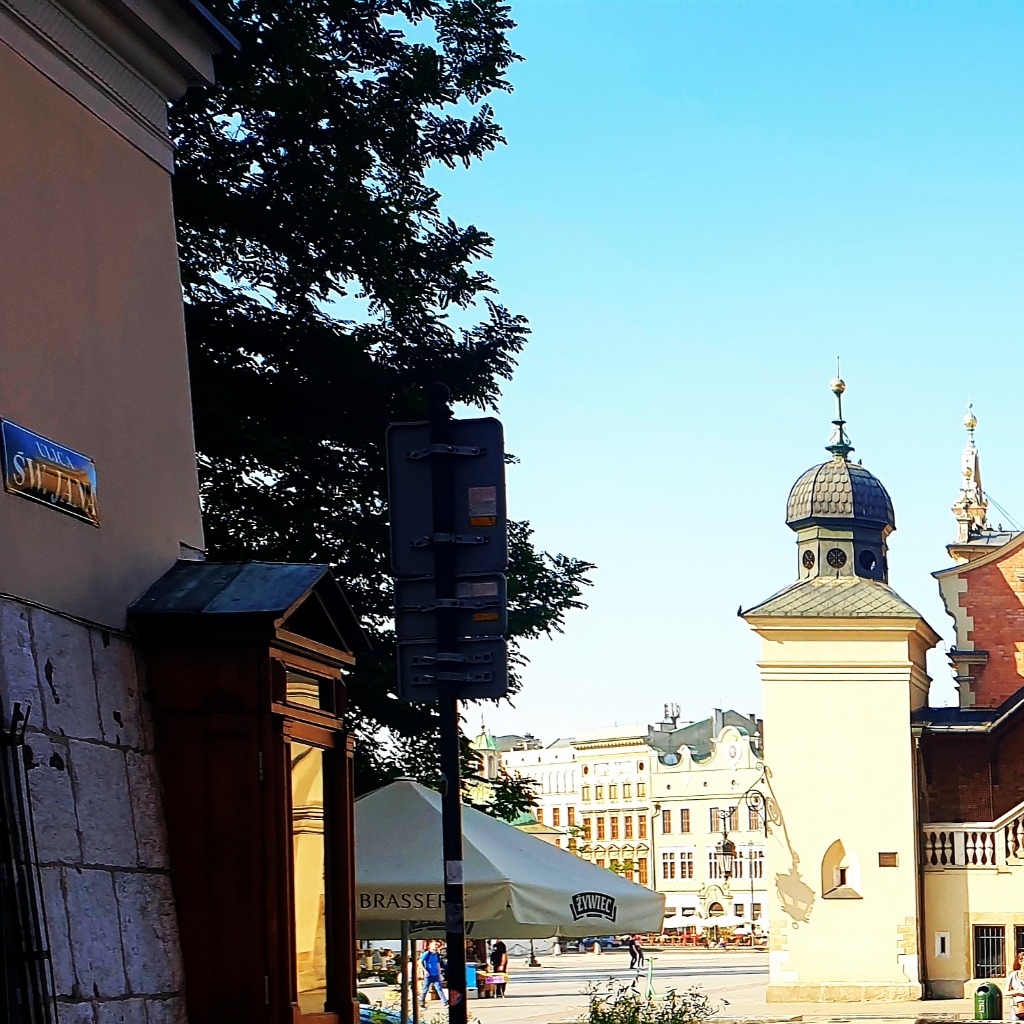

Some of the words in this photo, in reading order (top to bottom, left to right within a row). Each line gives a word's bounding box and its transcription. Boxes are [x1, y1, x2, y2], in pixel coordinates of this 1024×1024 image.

[35, 441, 76, 471] ULICA
[51, 470, 97, 516] JANA
[575, 894, 612, 912] ŻYWIEC
